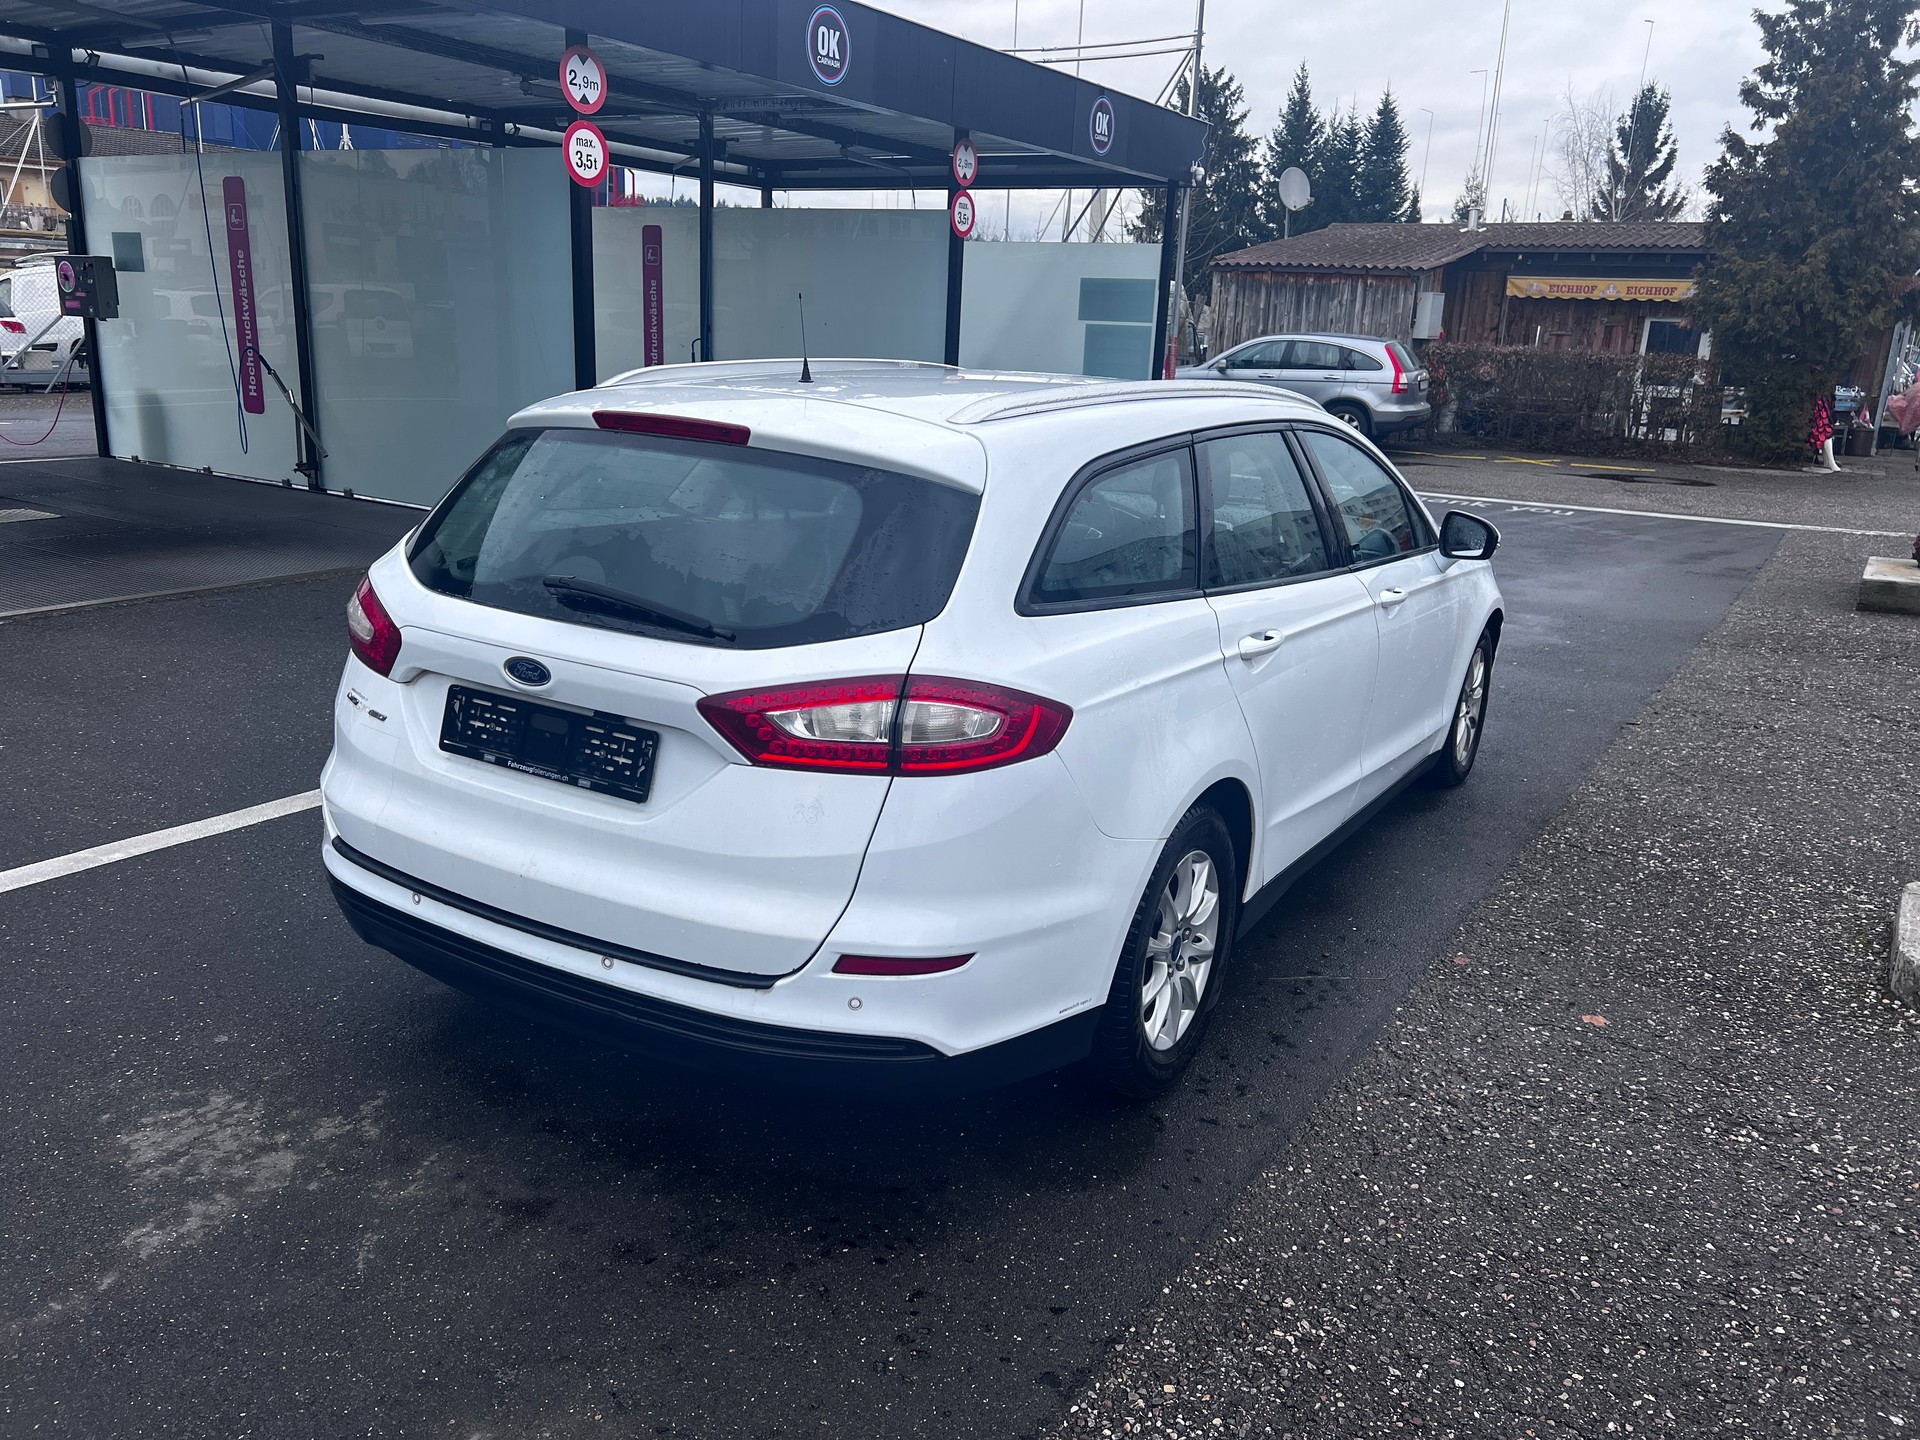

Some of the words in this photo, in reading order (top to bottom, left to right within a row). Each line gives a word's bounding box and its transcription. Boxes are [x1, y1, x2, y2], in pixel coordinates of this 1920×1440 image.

[817, 25, 840, 60] OK
[816, 55, 841, 69] CARWASH
[568, 68, 599, 92] 2,9m
[1096, 112, 1109, 135] OK
[575, 137, 596, 149] max.
[1548, 284, 1598, 295] EICHHOF
[1625, 286, 1678, 296] EICHHOF
[1505, 505, 1575, 516] you
[514, 662, 540, 680] Ford
